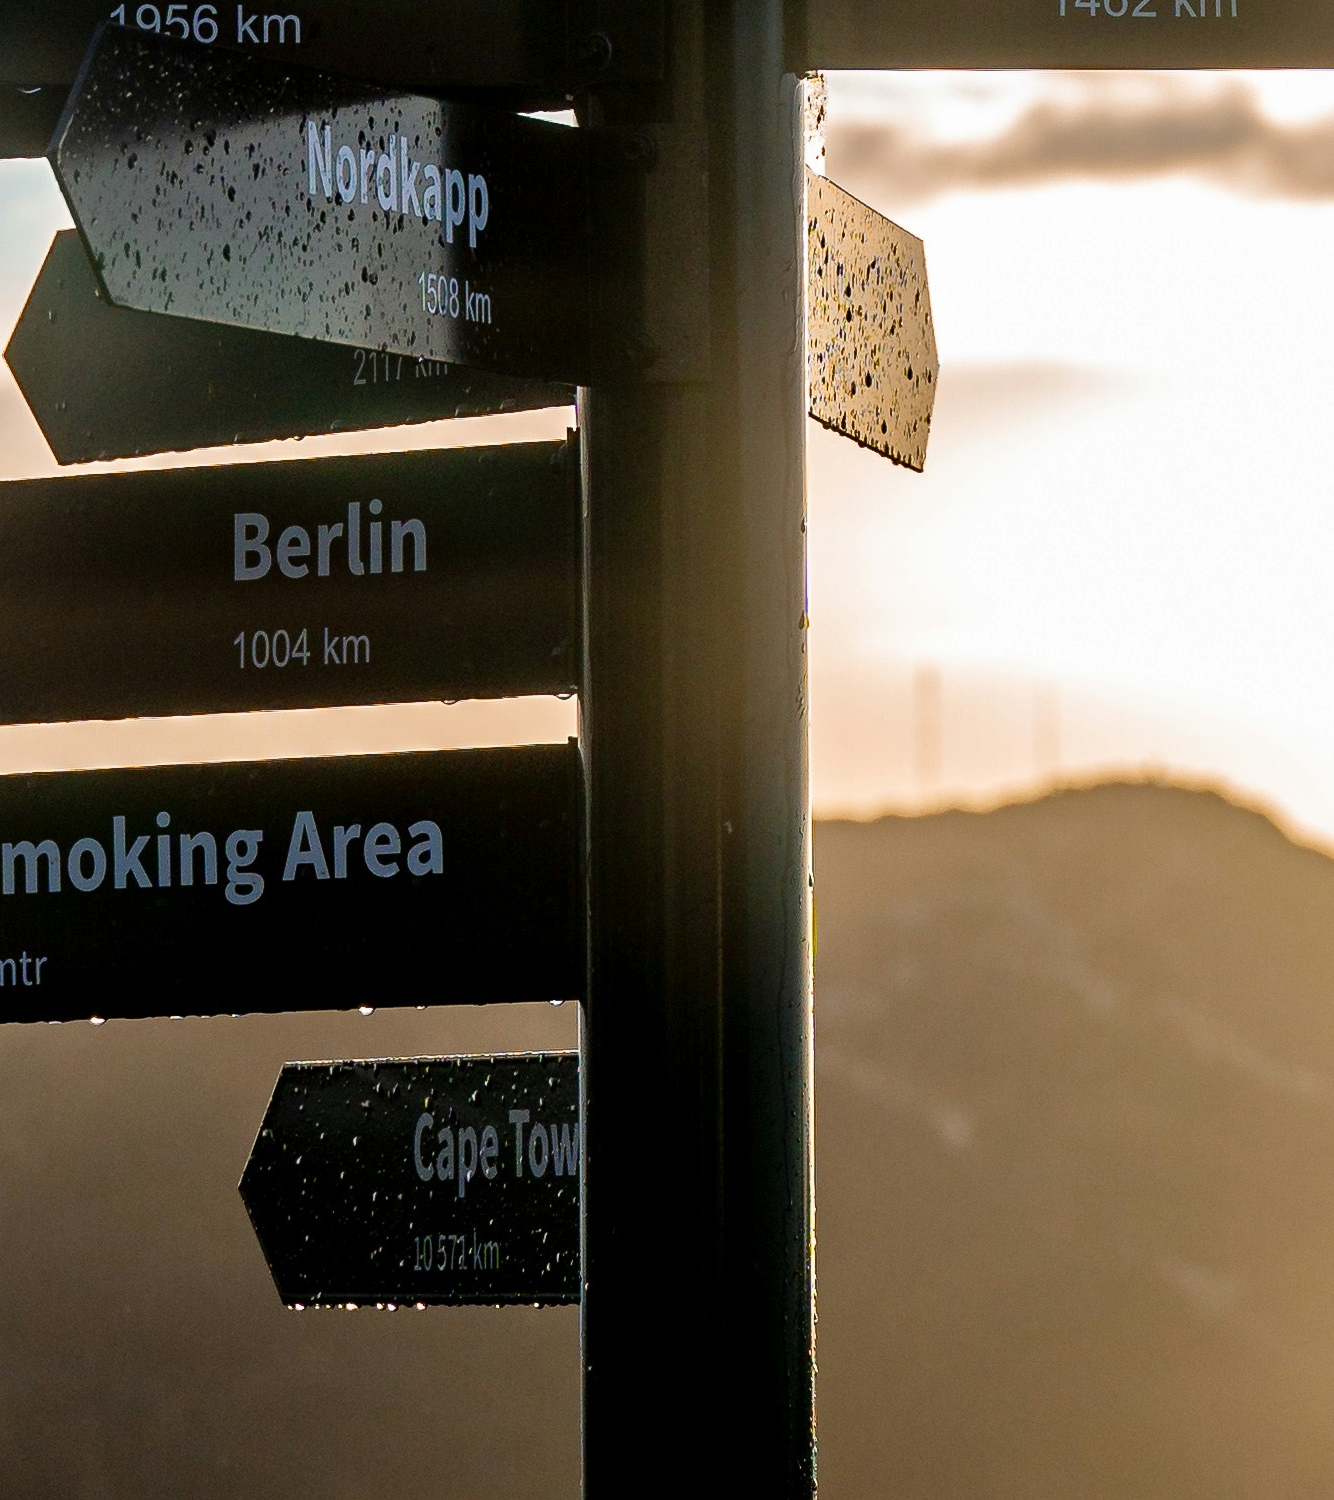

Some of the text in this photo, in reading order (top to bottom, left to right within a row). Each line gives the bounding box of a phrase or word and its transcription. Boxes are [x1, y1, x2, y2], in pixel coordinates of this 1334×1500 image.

[110, 3, 301, 44] 1956 km
[307, 120, 489, 248] Nordkapp
[418, 270, 492, 325] 1508 km
[234, 498, 427, 581] Berlin
[233, 627, 370, 669] 1004 km
[282, 810, 444, 881] Area
[413, 1109, 580, 1198] Cape Tow
[473, 1230, 500, 1270] km
